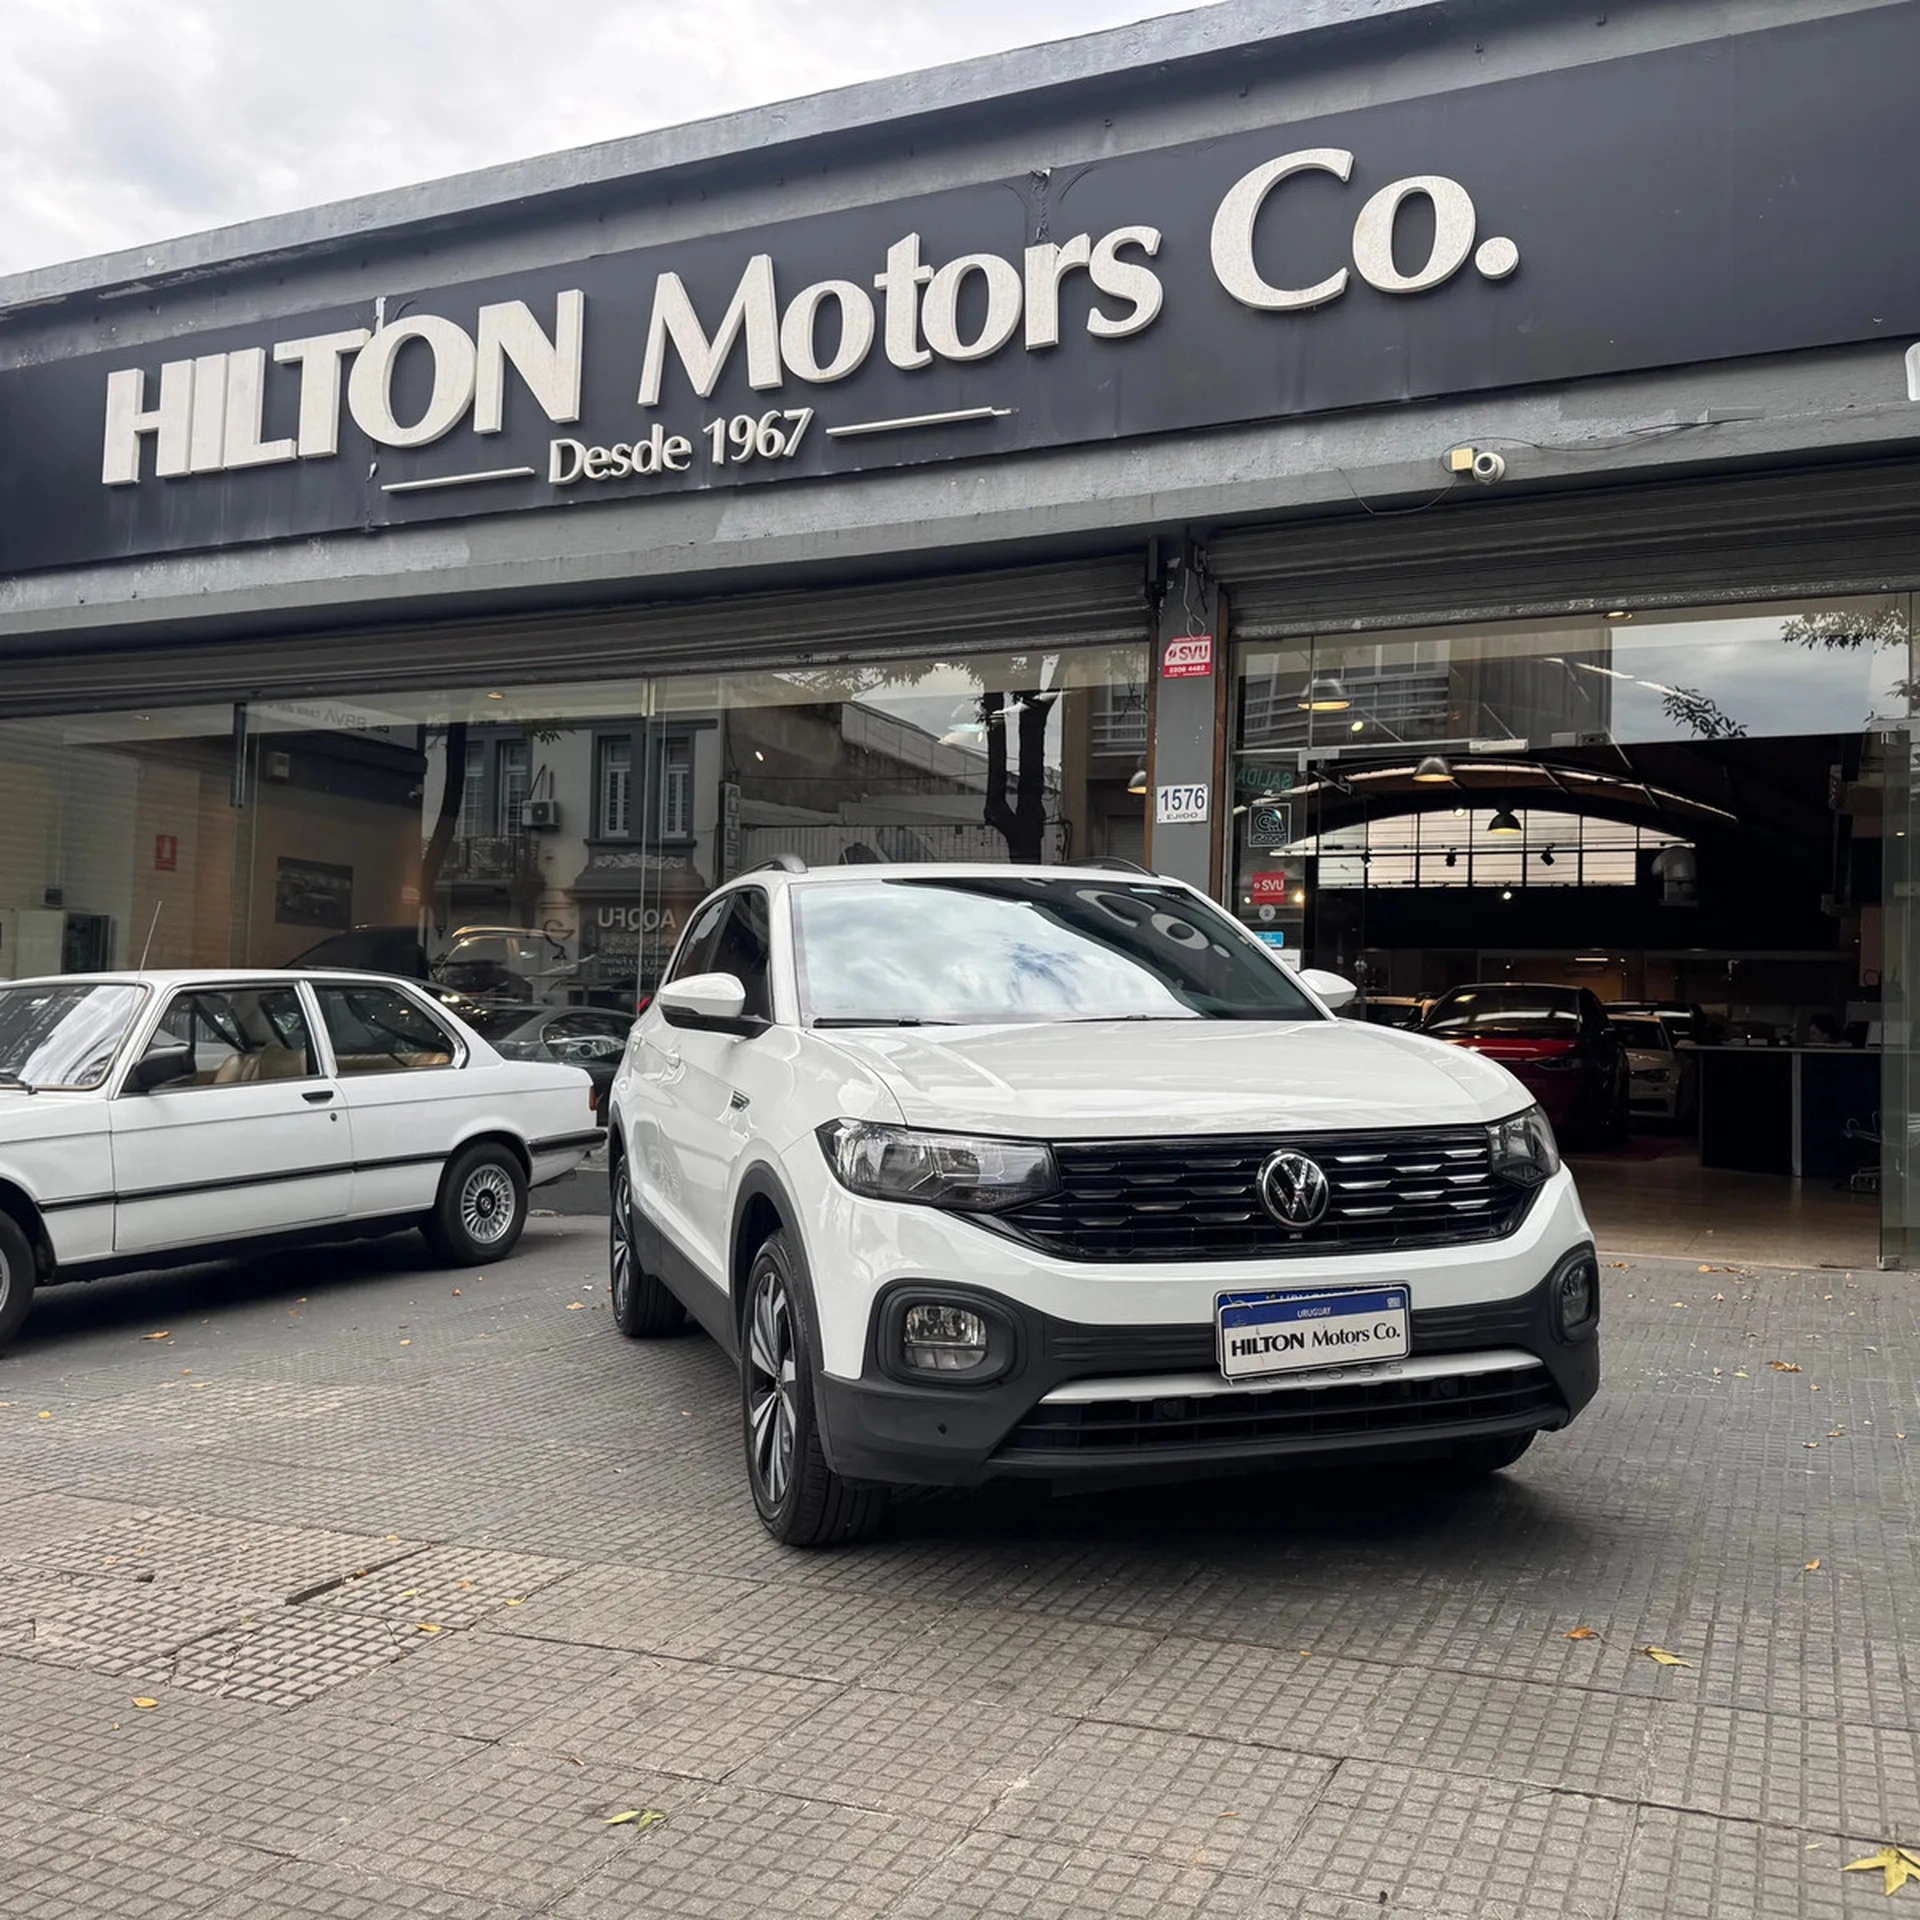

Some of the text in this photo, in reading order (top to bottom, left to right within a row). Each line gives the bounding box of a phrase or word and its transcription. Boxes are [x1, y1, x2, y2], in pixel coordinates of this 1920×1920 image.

[102, 148, 1519, 485] HILTON Motors Co.
[549, 407, 815, 485] Desde 1967
[1179, 645, 1208, 661] SVU
[1161, 787, 1205, 811] 1576
[1261, 879, 1284, 891] SVU
[1297, 1307, 1331, 1319] URUGUAY
[1231, 1322, 1401, 1357] HILTON Motors Co.
